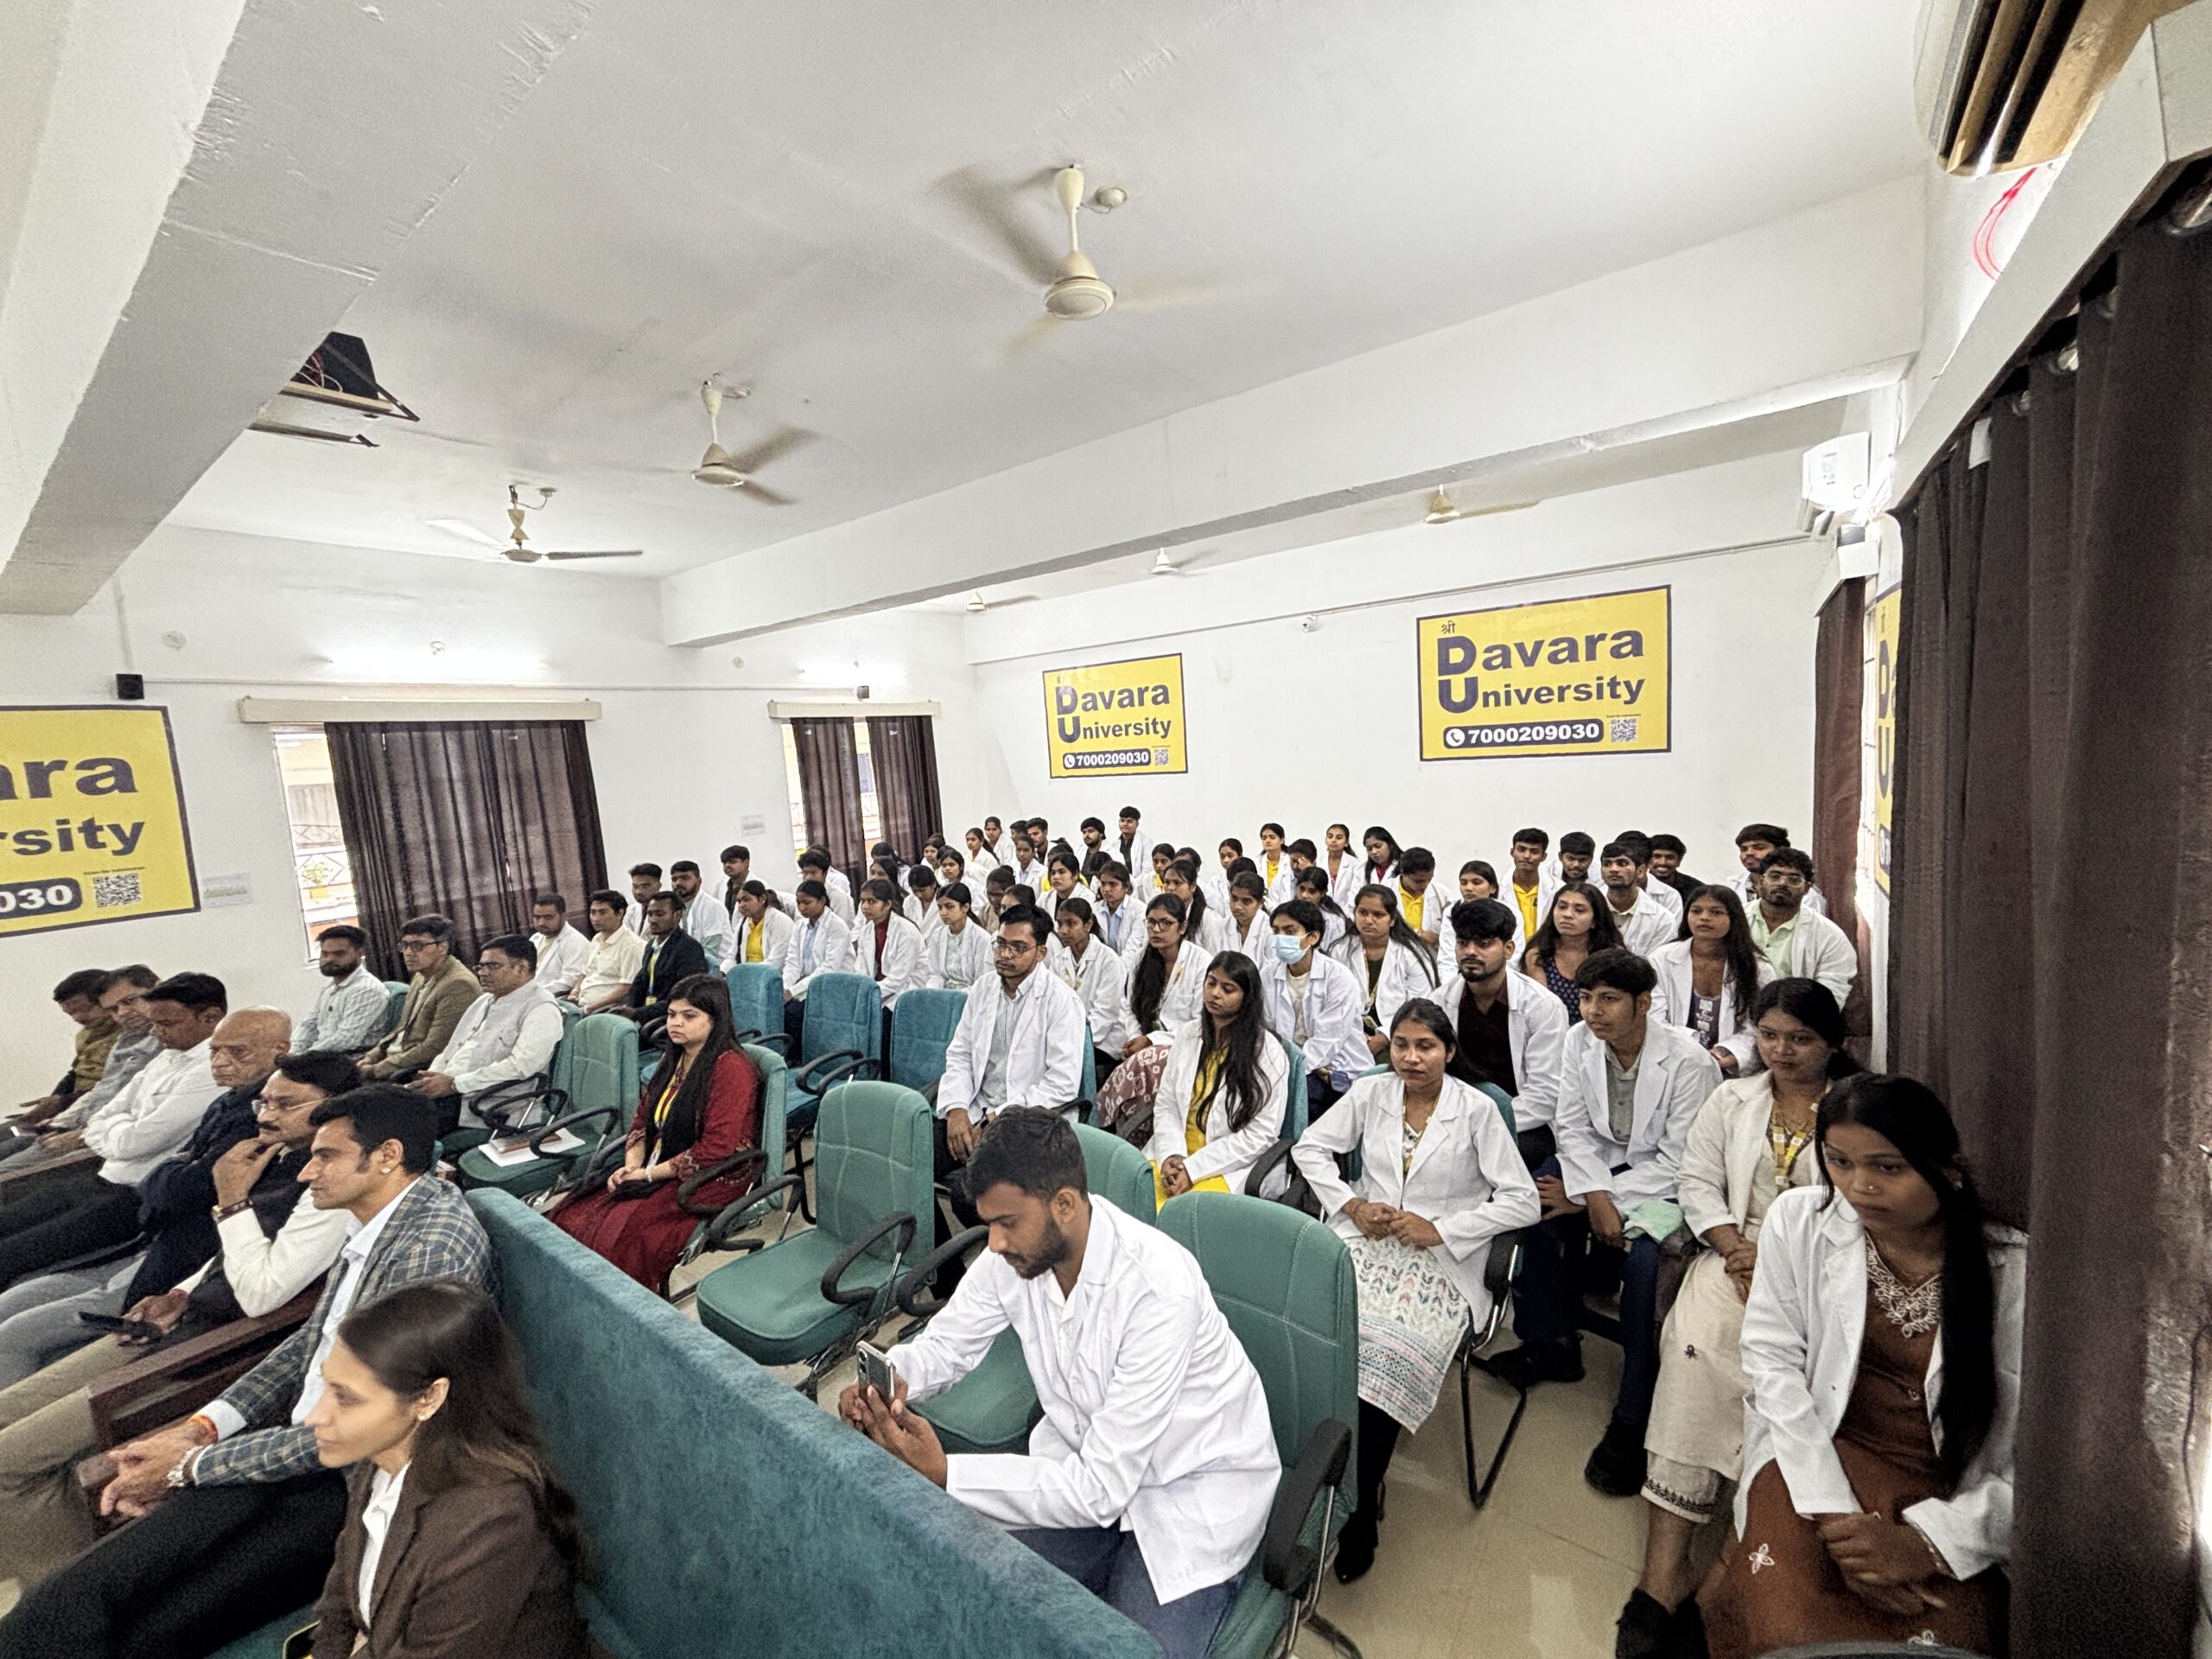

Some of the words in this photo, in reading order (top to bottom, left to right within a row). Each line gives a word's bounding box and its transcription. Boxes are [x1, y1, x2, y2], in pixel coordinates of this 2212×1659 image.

[1437, 630, 1644, 677] Davara
[1055, 683, 1170, 715] Davara
[1438, 675, 1645, 714] University
[1058, 715, 1172, 743] University
[1468, 722, 1599, 744] 7000209030
[1077, 752, 1148, 766] 7000209030
[0, 817, 145, 856] sity
